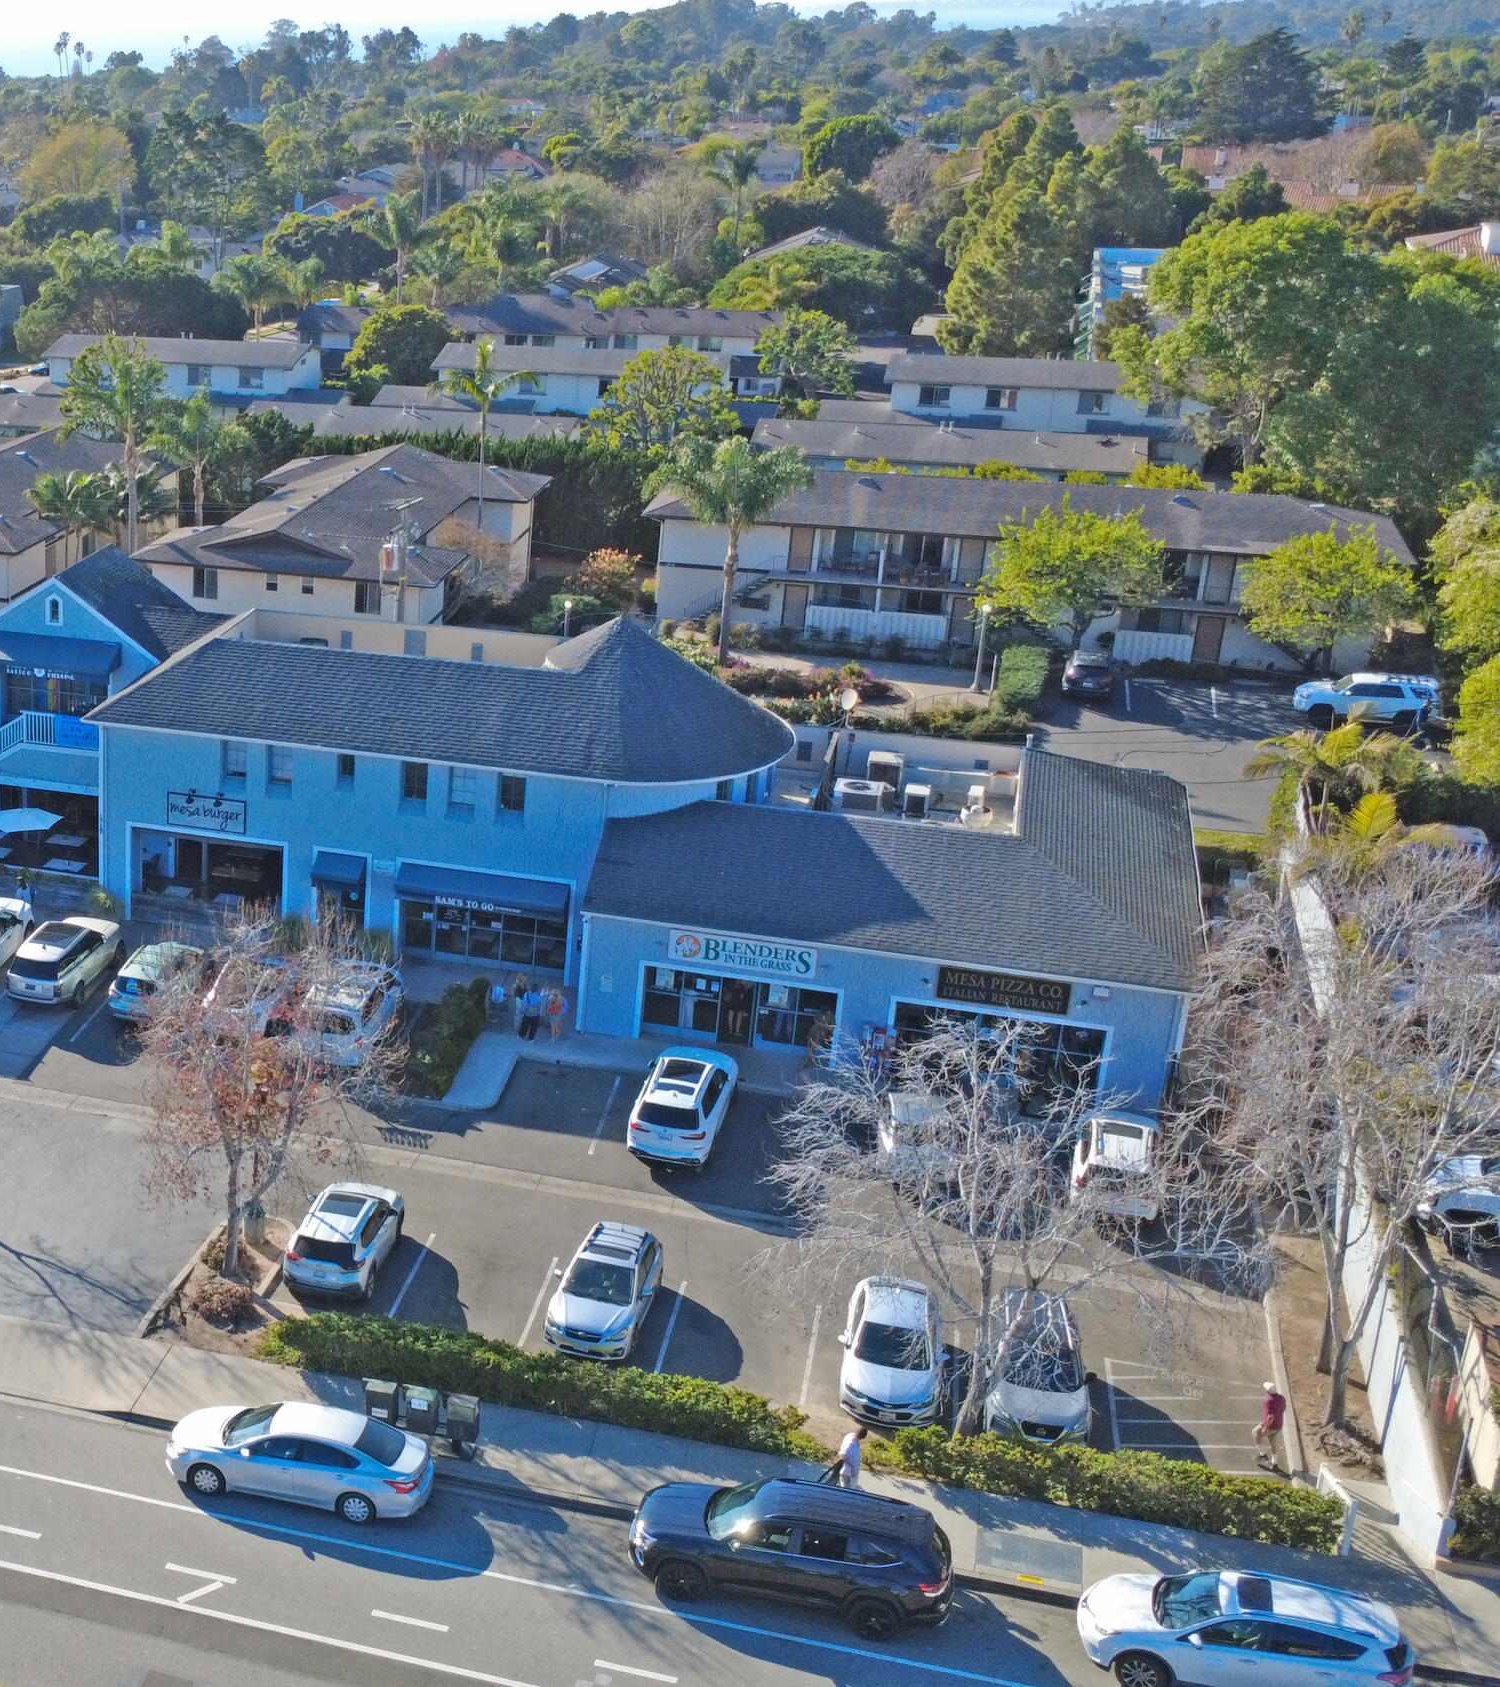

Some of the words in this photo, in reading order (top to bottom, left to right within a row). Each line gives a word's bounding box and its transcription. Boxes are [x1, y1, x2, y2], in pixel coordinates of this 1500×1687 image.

[170, 802, 200, 817] mesa
[202, 804, 241, 830] burger
[434, 895, 463, 908] SAM'S
[466, 900, 479, 909] TO
[481, 901, 495, 912] GO
[723, 953, 736, 964] IN
[736, 955, 758, 968] THE
[760, 958, 792, 972] GRASS
[946, 971, 986, 988] MESA
[991, 977, 1035, 995] PIZZA
[1039, 983, 1064, 999] CO.
[942, 986, 987, 1001] ITALIAN
[991, 993, 1064, 1011] RESTAURANT
